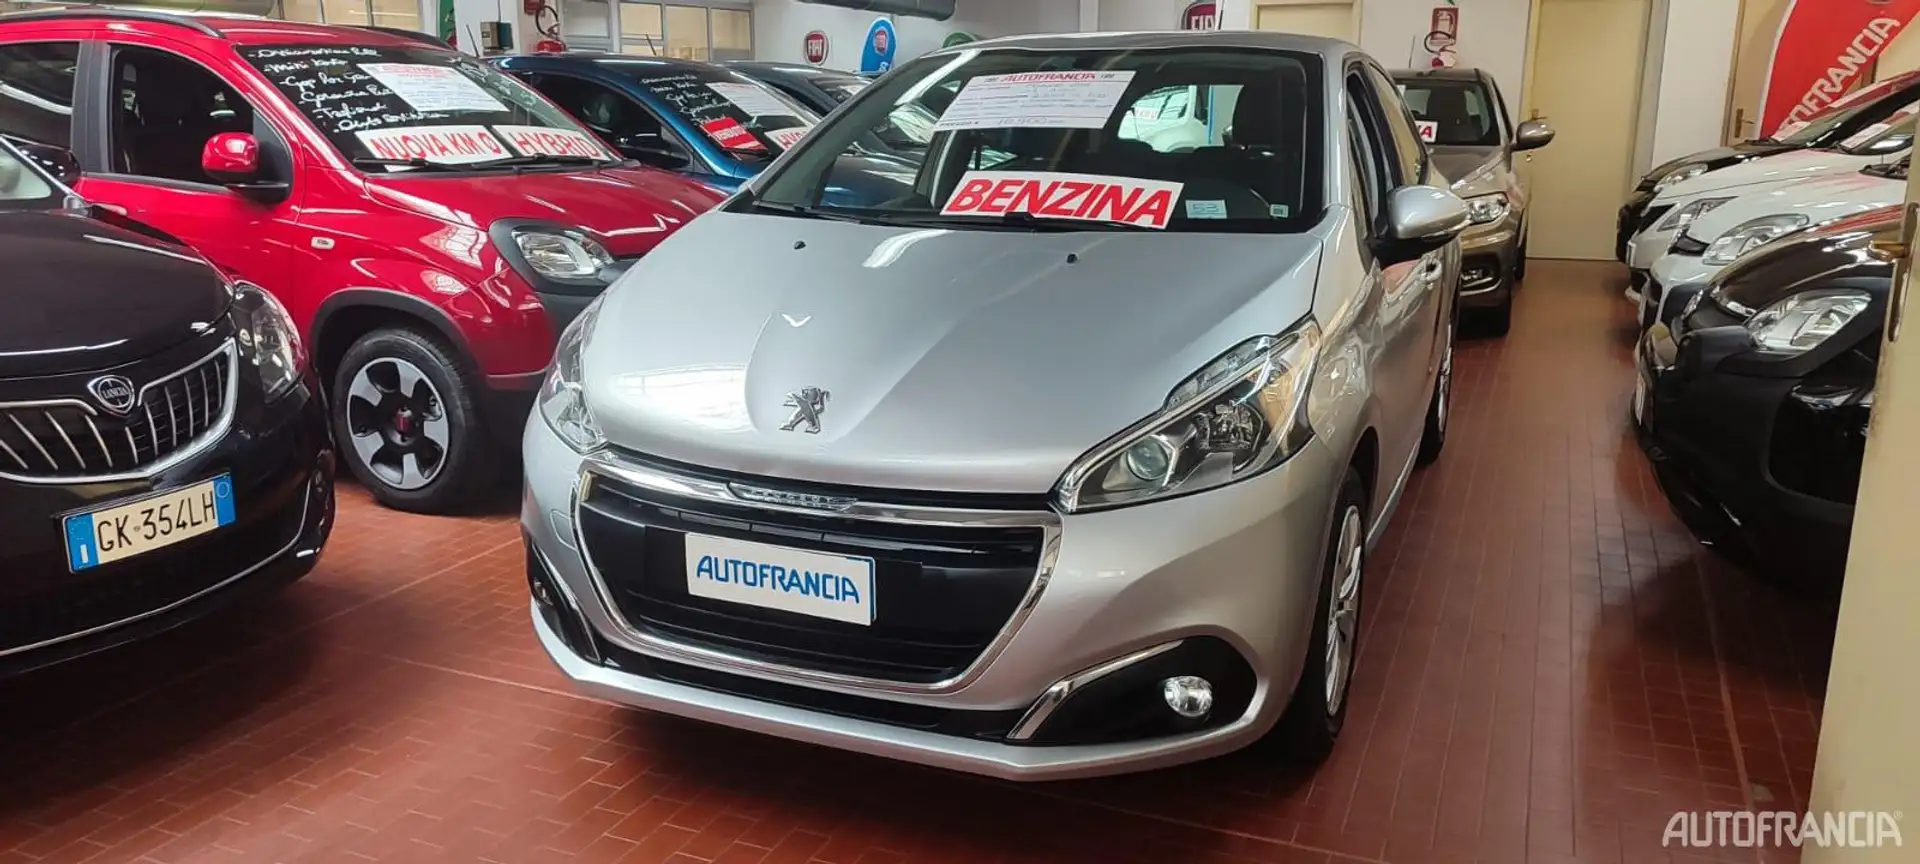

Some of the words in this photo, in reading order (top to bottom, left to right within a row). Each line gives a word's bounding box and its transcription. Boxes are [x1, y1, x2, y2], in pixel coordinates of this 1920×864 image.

[1190, 14, 1216, 31] FIA
[1000, 72, 1096, 82] AUTOFRANCIA
[370, 133, 454, 161] NUOVA
[443, 132, 487, 155] KM
[508, 131, 601, 157] HYBRID
[945, 178, 1173, 226] BENZINA
[102, 386, 129, 399] LANCIA
[97, 514, 132, 551] GK
[140, 490, 216, 540] 354LH
[696, 555, 860, 604] AUTOFRANCIA
